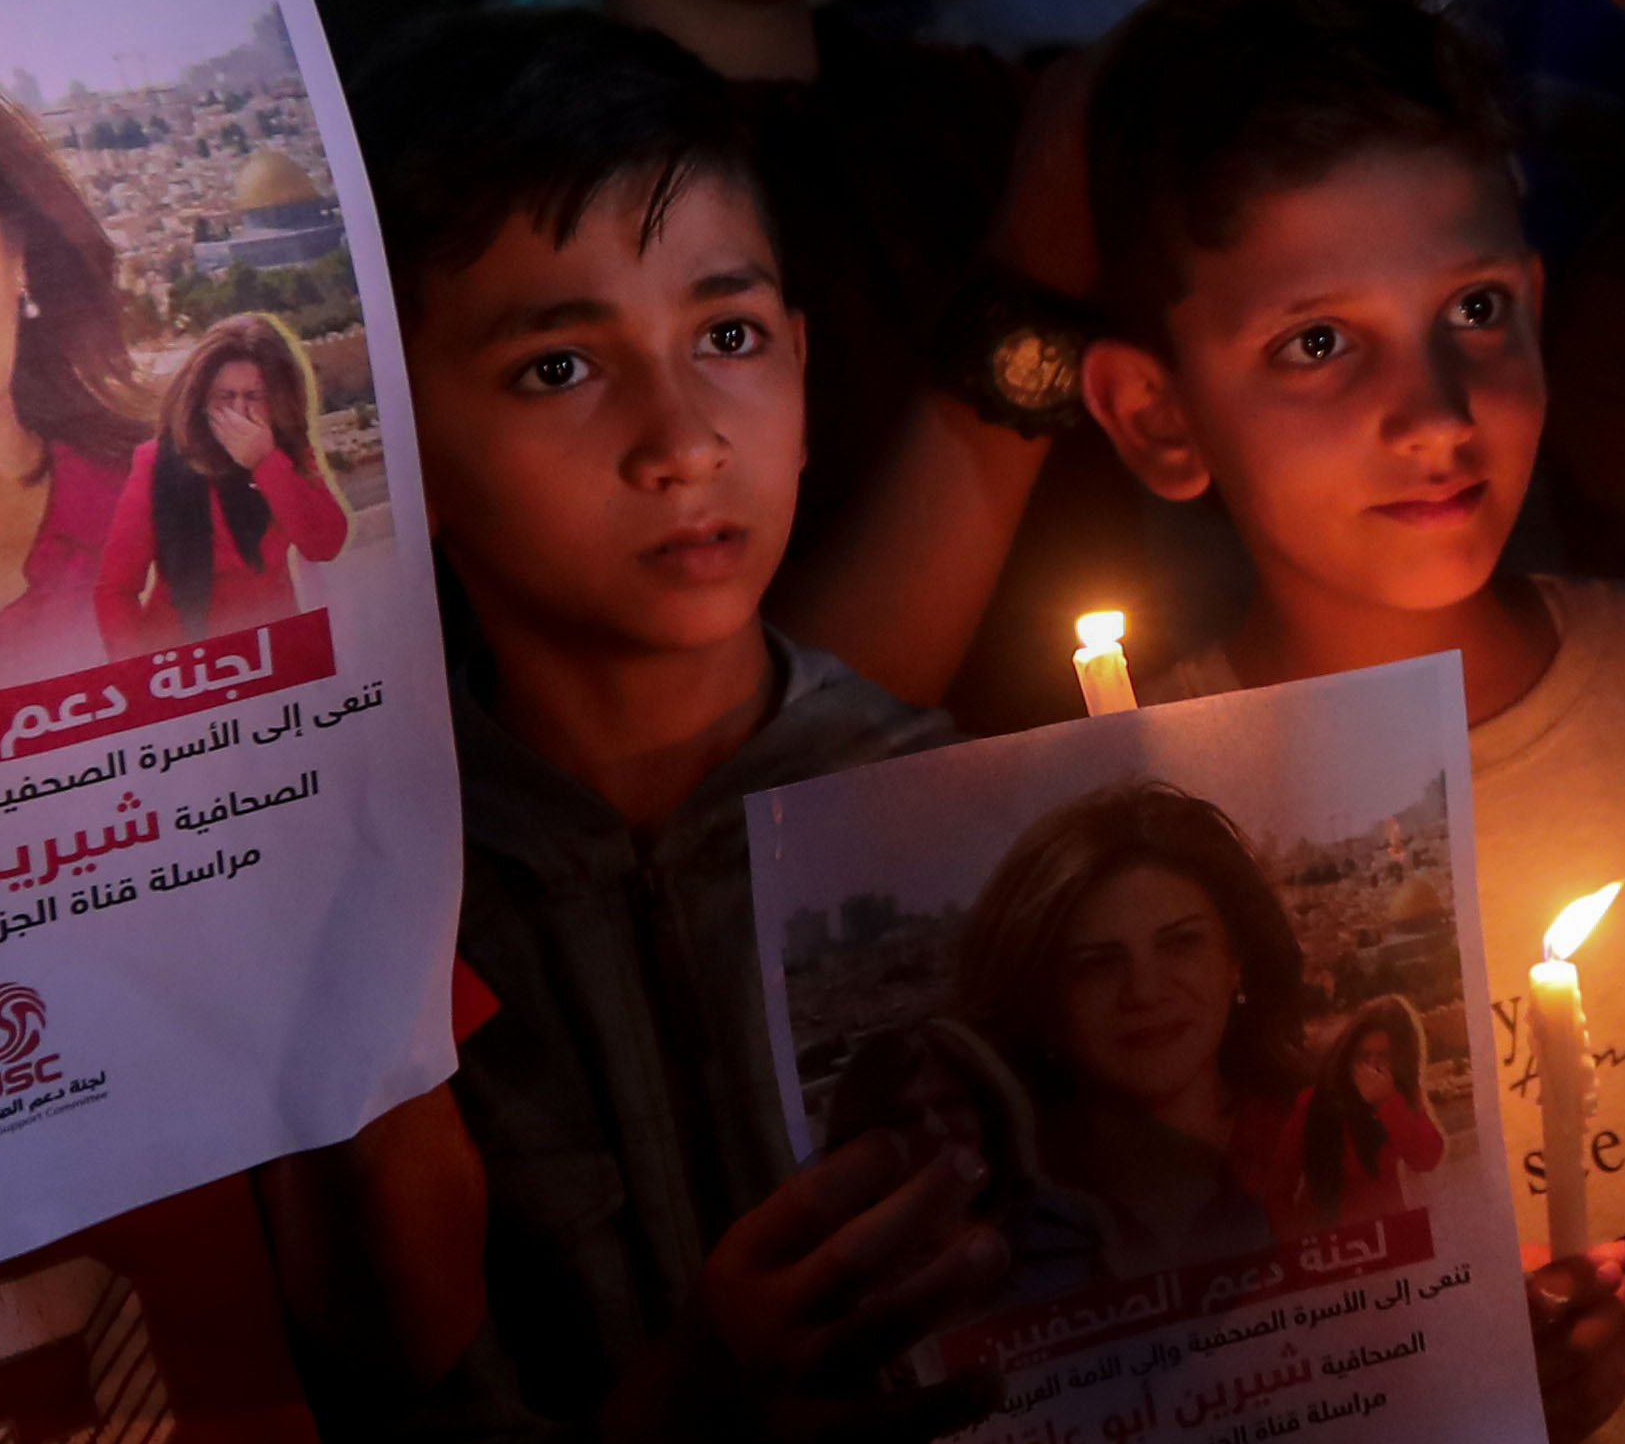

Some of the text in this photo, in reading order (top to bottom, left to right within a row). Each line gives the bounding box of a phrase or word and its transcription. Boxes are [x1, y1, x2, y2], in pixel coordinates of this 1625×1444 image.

[150, 628, 273, 699] لجنة
[0, 685, 127, 757] دعم
[254, 704, 300, 743] إلى
[315, 682, 381, 731] تنعى
[141, 720, 238, 771] الأسرة
[176, 771, 317, 832] الصحافية
[151, 850, 259, 892] مراسلة
[72, 879, 135, 913] قناة
[29, 1088, 65, 1111] دعم
[69, 1070, 106, 1093] لجنة
[1523, 1129, 1625, 1196] se
[1299, 1221, 1387, 1271] لجنة
[1201, 1262, 1284, 1312] دعم
[1000, 1267, 1469, 1412] تنعى إلى الأسرة الصحفية وإلى الأمة العربي
[1323, 1333, 1424, 1375] الصحافية
[1172, 1344, 1310, 1431] شيرين
[1309, 1394, 1385, 1424] مراسلة
[1257, 1417, 1299, 1439] قناة
